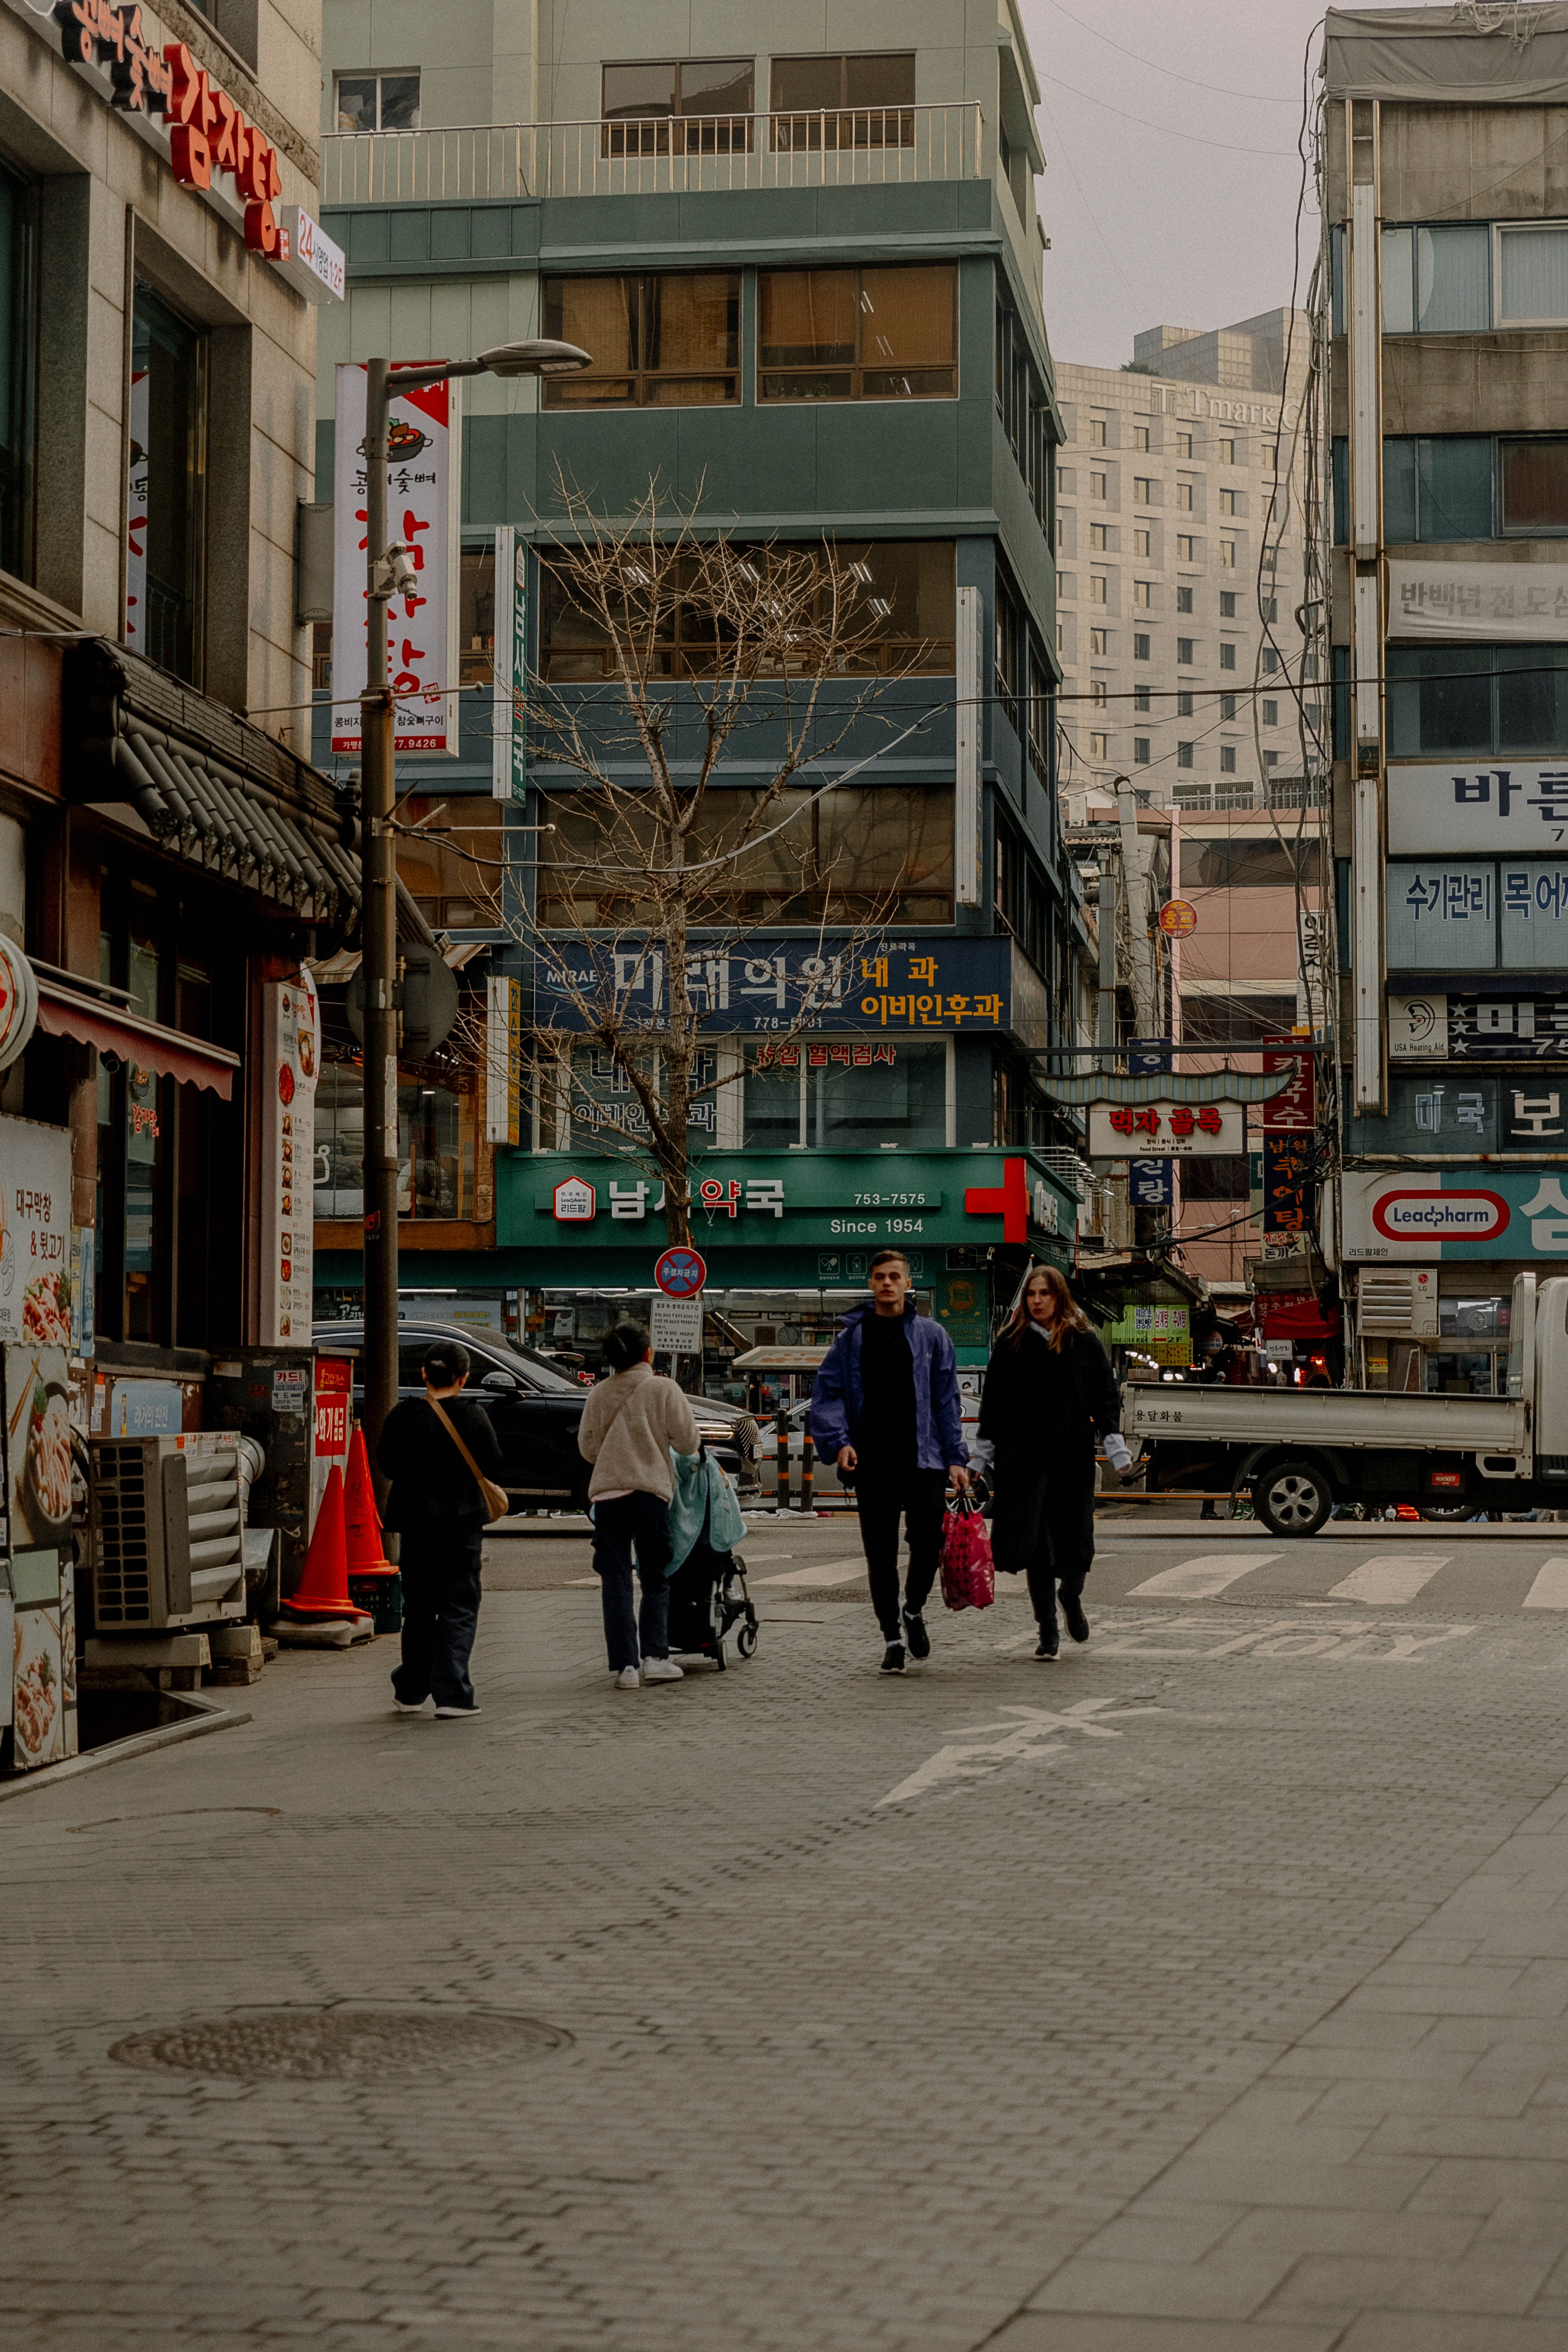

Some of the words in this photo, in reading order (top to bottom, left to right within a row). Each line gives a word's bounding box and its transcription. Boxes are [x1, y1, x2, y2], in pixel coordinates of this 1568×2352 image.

[181, 43, 282, 252] 감자탕
[299, 214, 329, 280] 24시영업
[1186, 387, 1276, 428] Tmark
[350, 468, 436, 495] 콩숯뼈
[1406, 874, 1492, 921] 수기관리
[1163, 911, 1193, 929] 호프
[546, 970, 598, 983] MIRAE
[610, 949, 842, 1011] 미래의원
[860, 994, 1004, 1025] 이비인후과
[808, 1044, 896, 1066] 혈액검사
[1394, 1043, 1408, 1052] USA
[1409, 1042, 1432, 1054] Hearing
[1434, 1042, 1444, 1052] Aid
[1272, 1055, 1309, 1126] 칼국수
[133, 1103, 157, 1138] 감자탕
[574, 1102, 717, 1132] 이비인과
[1109, 1107, 1161, 1135] 먹자
[1168, 1107, 1222, 1135] 골목
[16, 1189, 52, 1224] 대구막창
[561, 1204, 586, 1213] 리드팜
[854, 1193, 926, 1205] 753-7575
[830, 1219, 877, 1233] Since
[885, 1219, 923, 1233] 1954
[1393, 1206, 1489, 1227] Leadpharm
[30, 1230, 37, 1257] &
[40, 1232, 65, 1264] 뒷고기
[1265, 1246, 1301, 1260] 돈까스
[1349, 1248, 1388, 1257] 리드팜체인
[663, 1267, 698, 1278] 주정차금지
[1155, 1310, 1169, 1329] 삼계탕
[277, 1372, 298, 1382] 카드
[324, 1373, 345, 1385] 고압가스
[318, 1407, 344, 1442] 화기엄금
[1135, 1409, 1183, 1422] 용달화물
